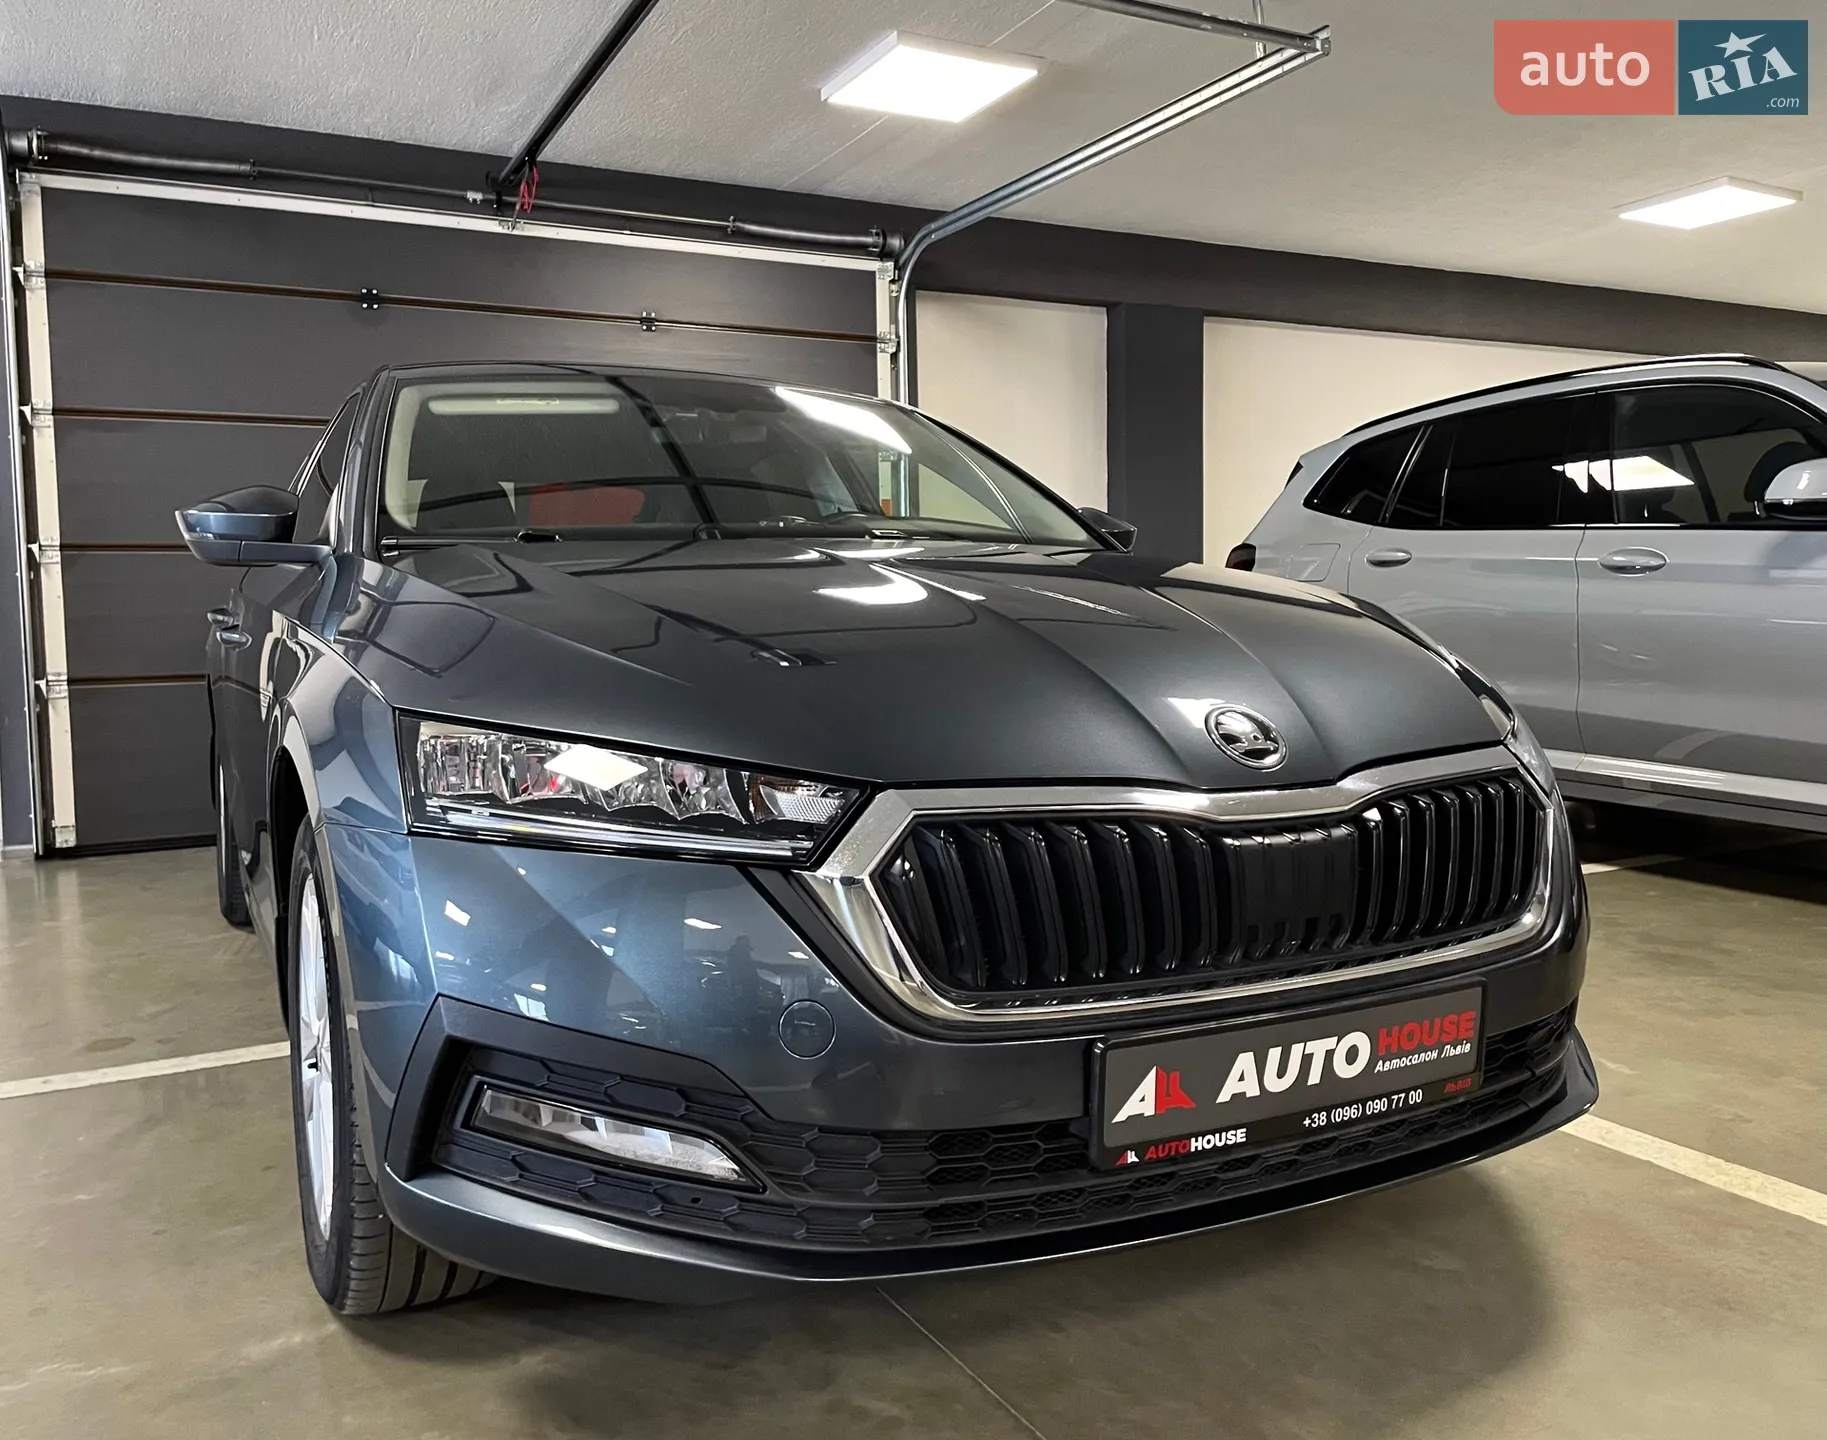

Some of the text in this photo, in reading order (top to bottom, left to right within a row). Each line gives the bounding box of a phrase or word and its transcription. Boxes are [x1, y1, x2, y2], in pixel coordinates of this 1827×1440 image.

[1215, 1031, 1371, 1104] AUTO
[1378, 1011, 1477, 1056] HOUSE
[1374, 1040, 1472, 1073] Автосалон Львів
[1303, 1089, 1423, 1128] +38 (096) 090 77 00
